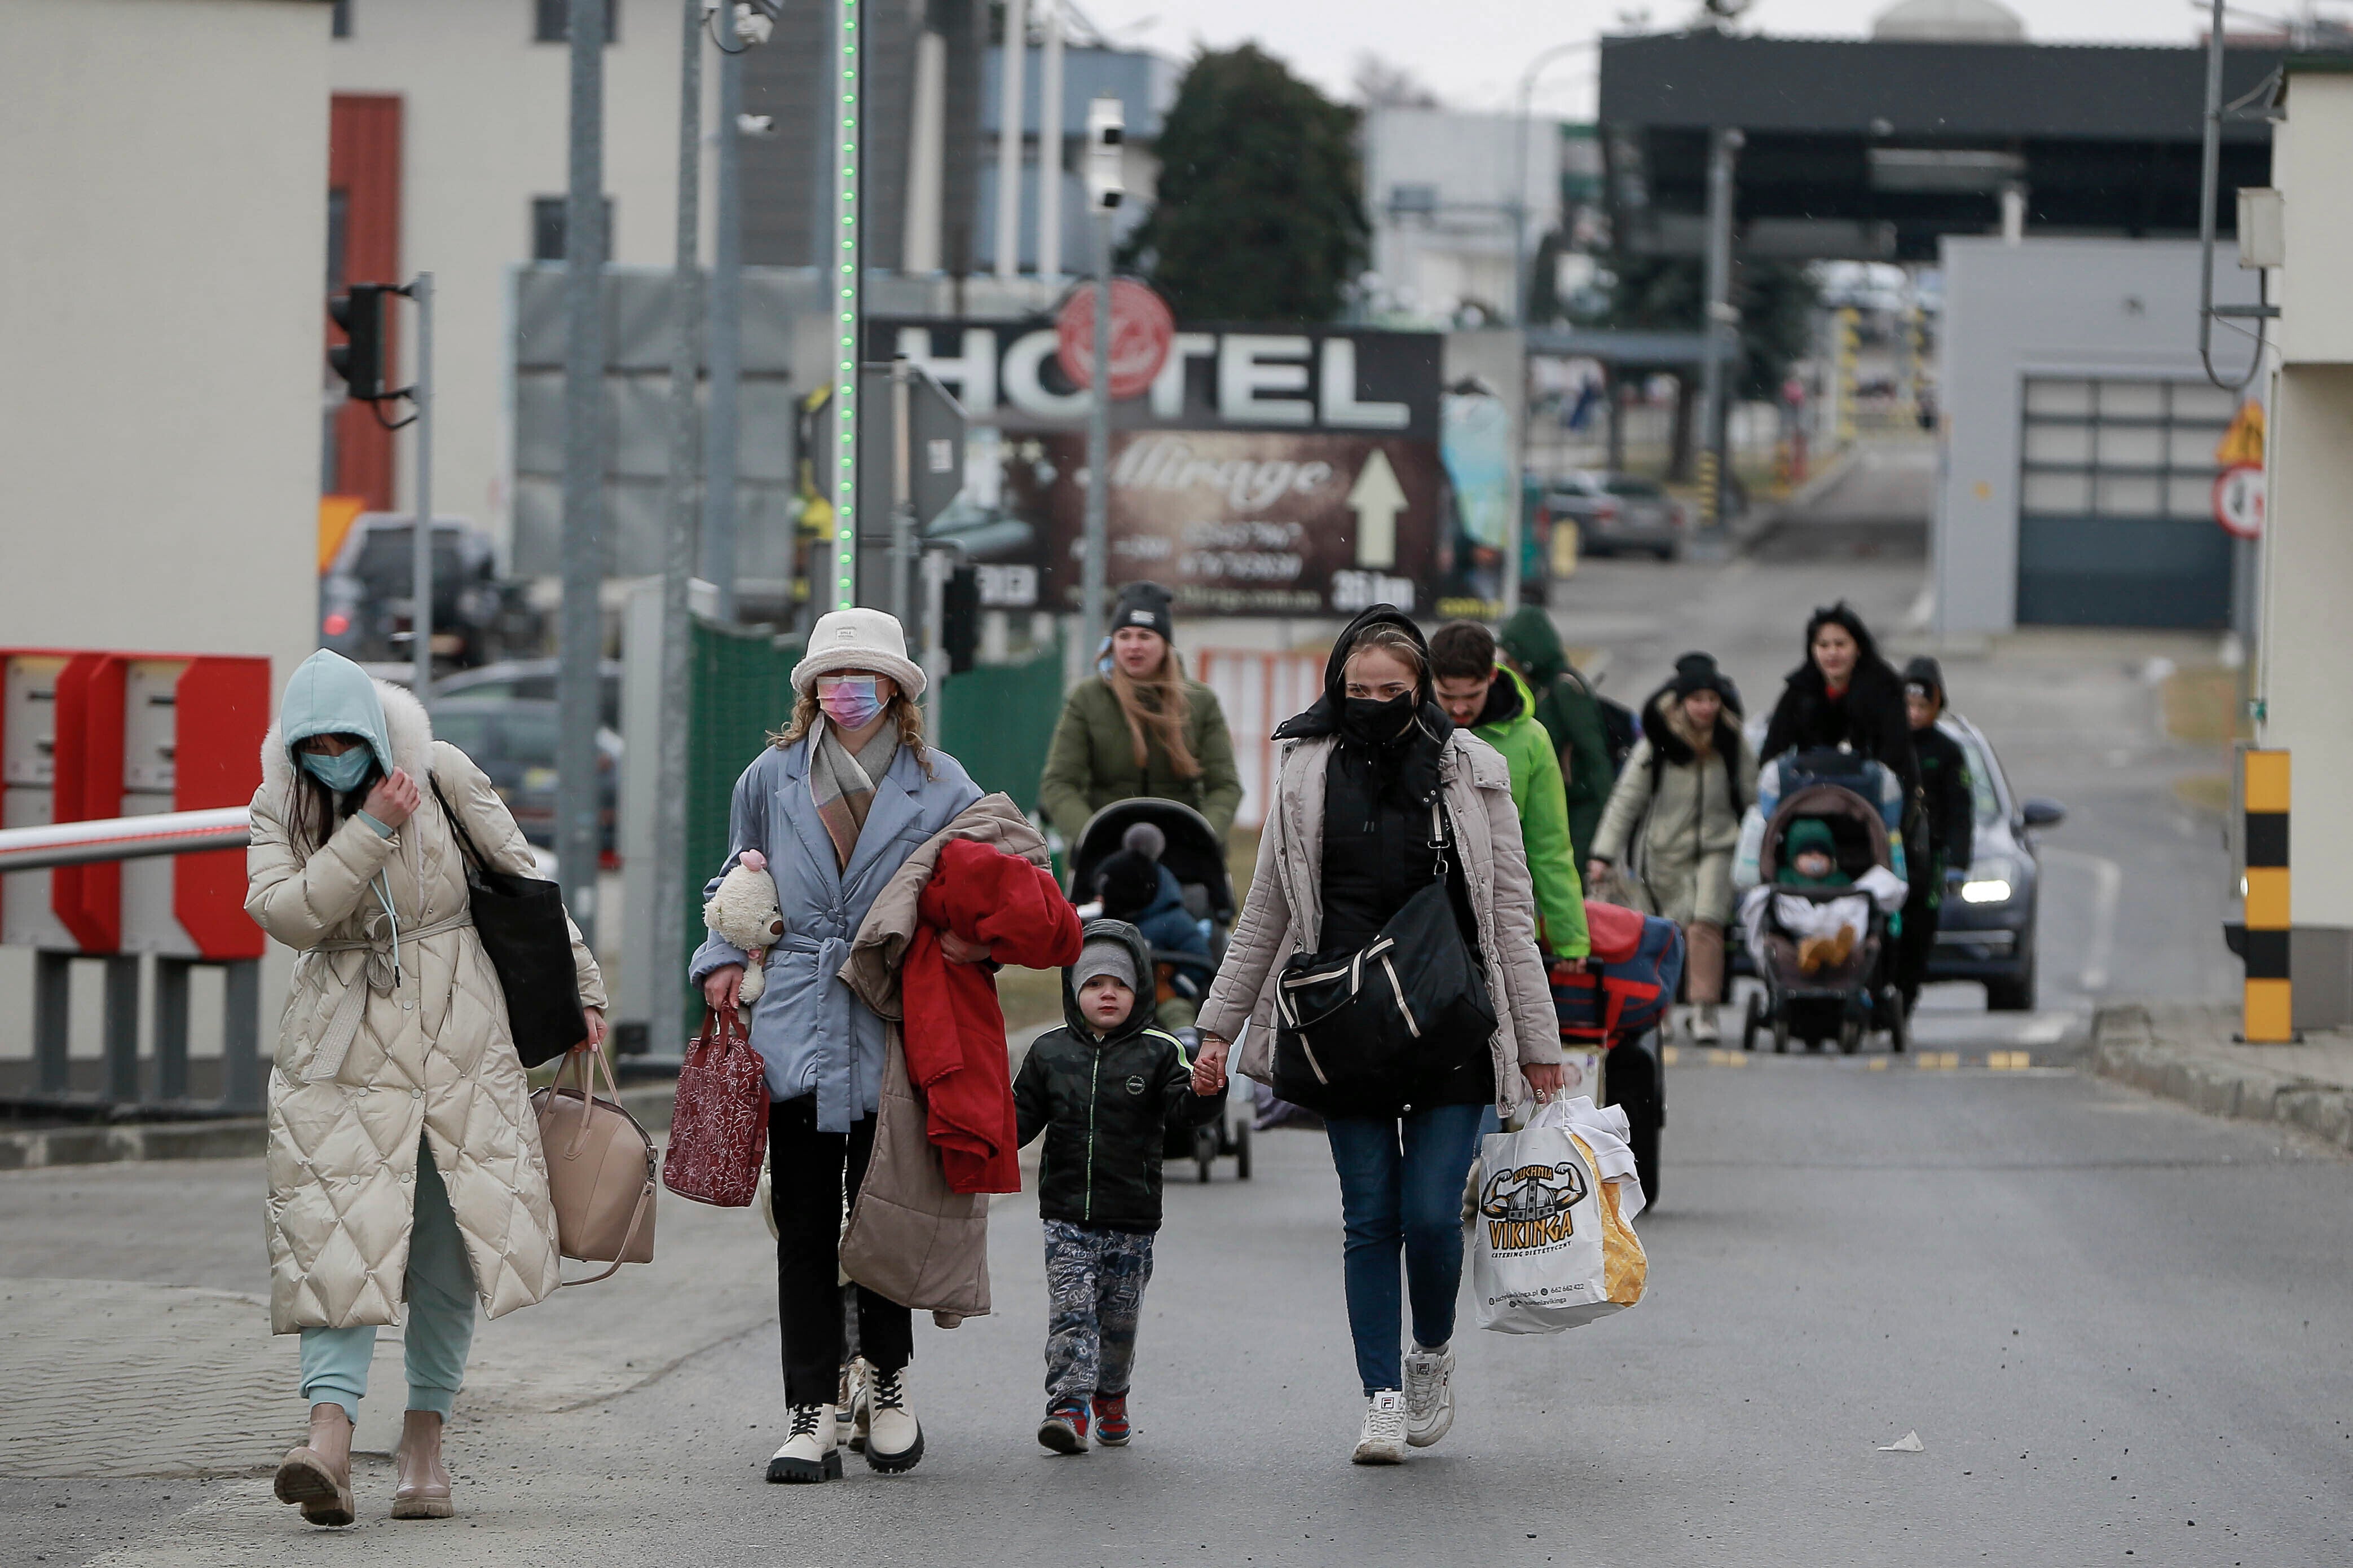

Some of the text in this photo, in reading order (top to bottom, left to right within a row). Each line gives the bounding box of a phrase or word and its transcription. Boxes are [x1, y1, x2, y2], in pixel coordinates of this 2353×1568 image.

[902, 323, 1411, 430] HOTEL
[1514, 1167, 1553, 1183] KUCHNIA
[1488, 1210, 1574, 1249] VIKINGA
[1525, 1241, 1571, 1256] DIETETYCZNY
